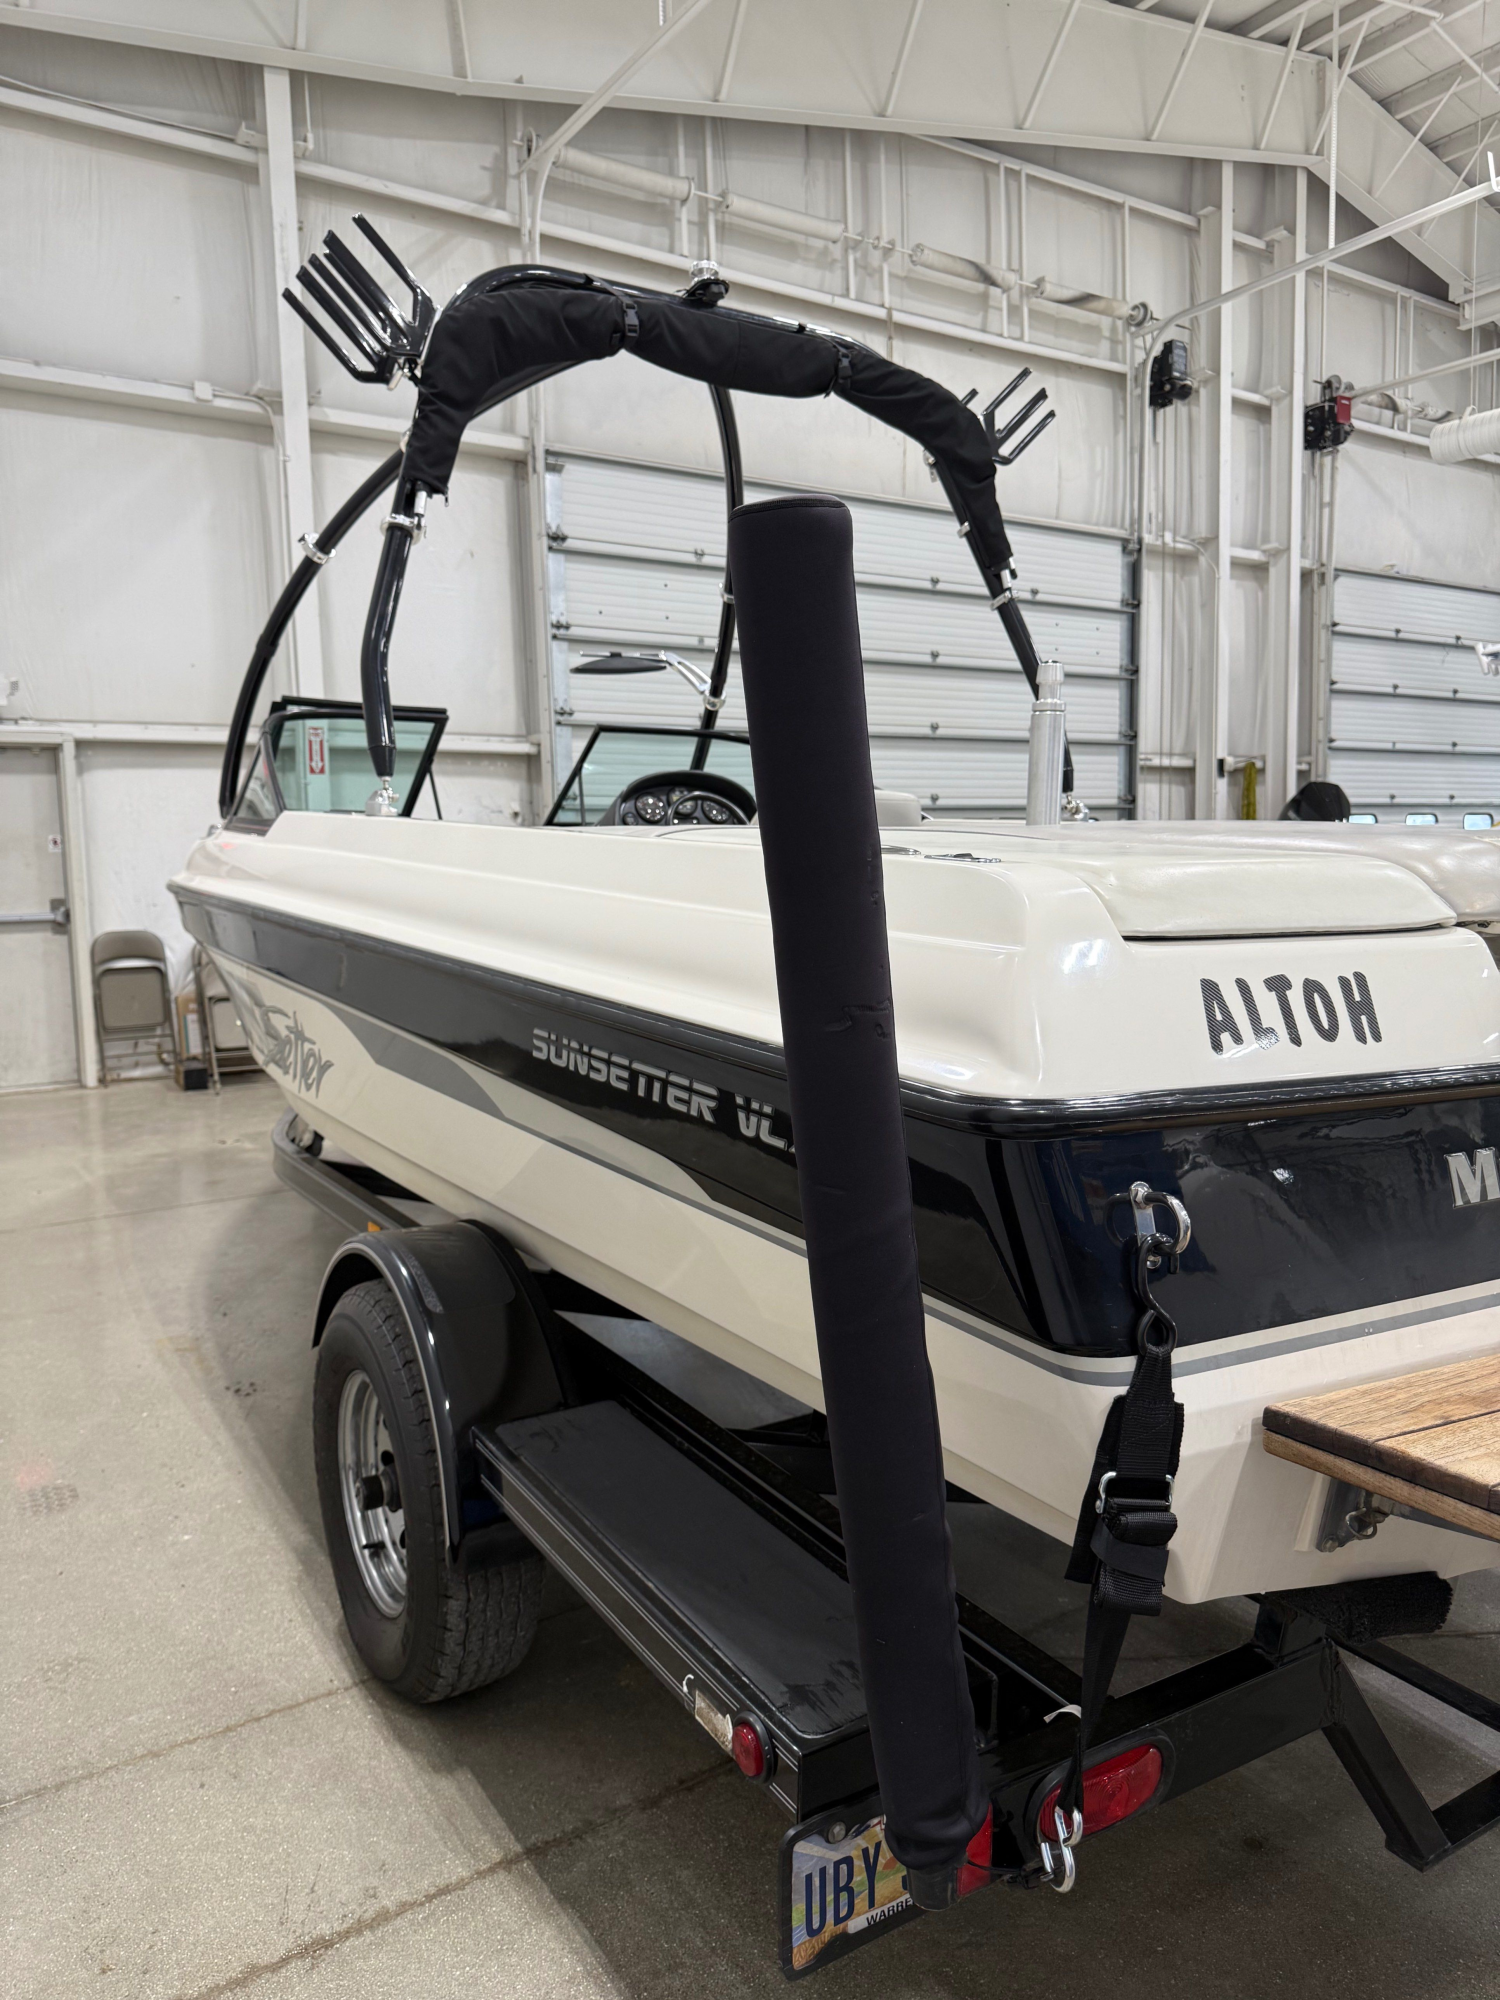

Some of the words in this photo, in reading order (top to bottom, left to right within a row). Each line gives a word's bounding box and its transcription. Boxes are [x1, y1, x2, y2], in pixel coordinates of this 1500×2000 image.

[1200, 971, 1382, 1055] ALTOH
[532, 1027, 720, 1124] SUNSETTER
[735, 1093, 797, 1154] VL
[804, 1840, 882, 1938] UBY
[866, 1896, 915, 1926] WARRE
